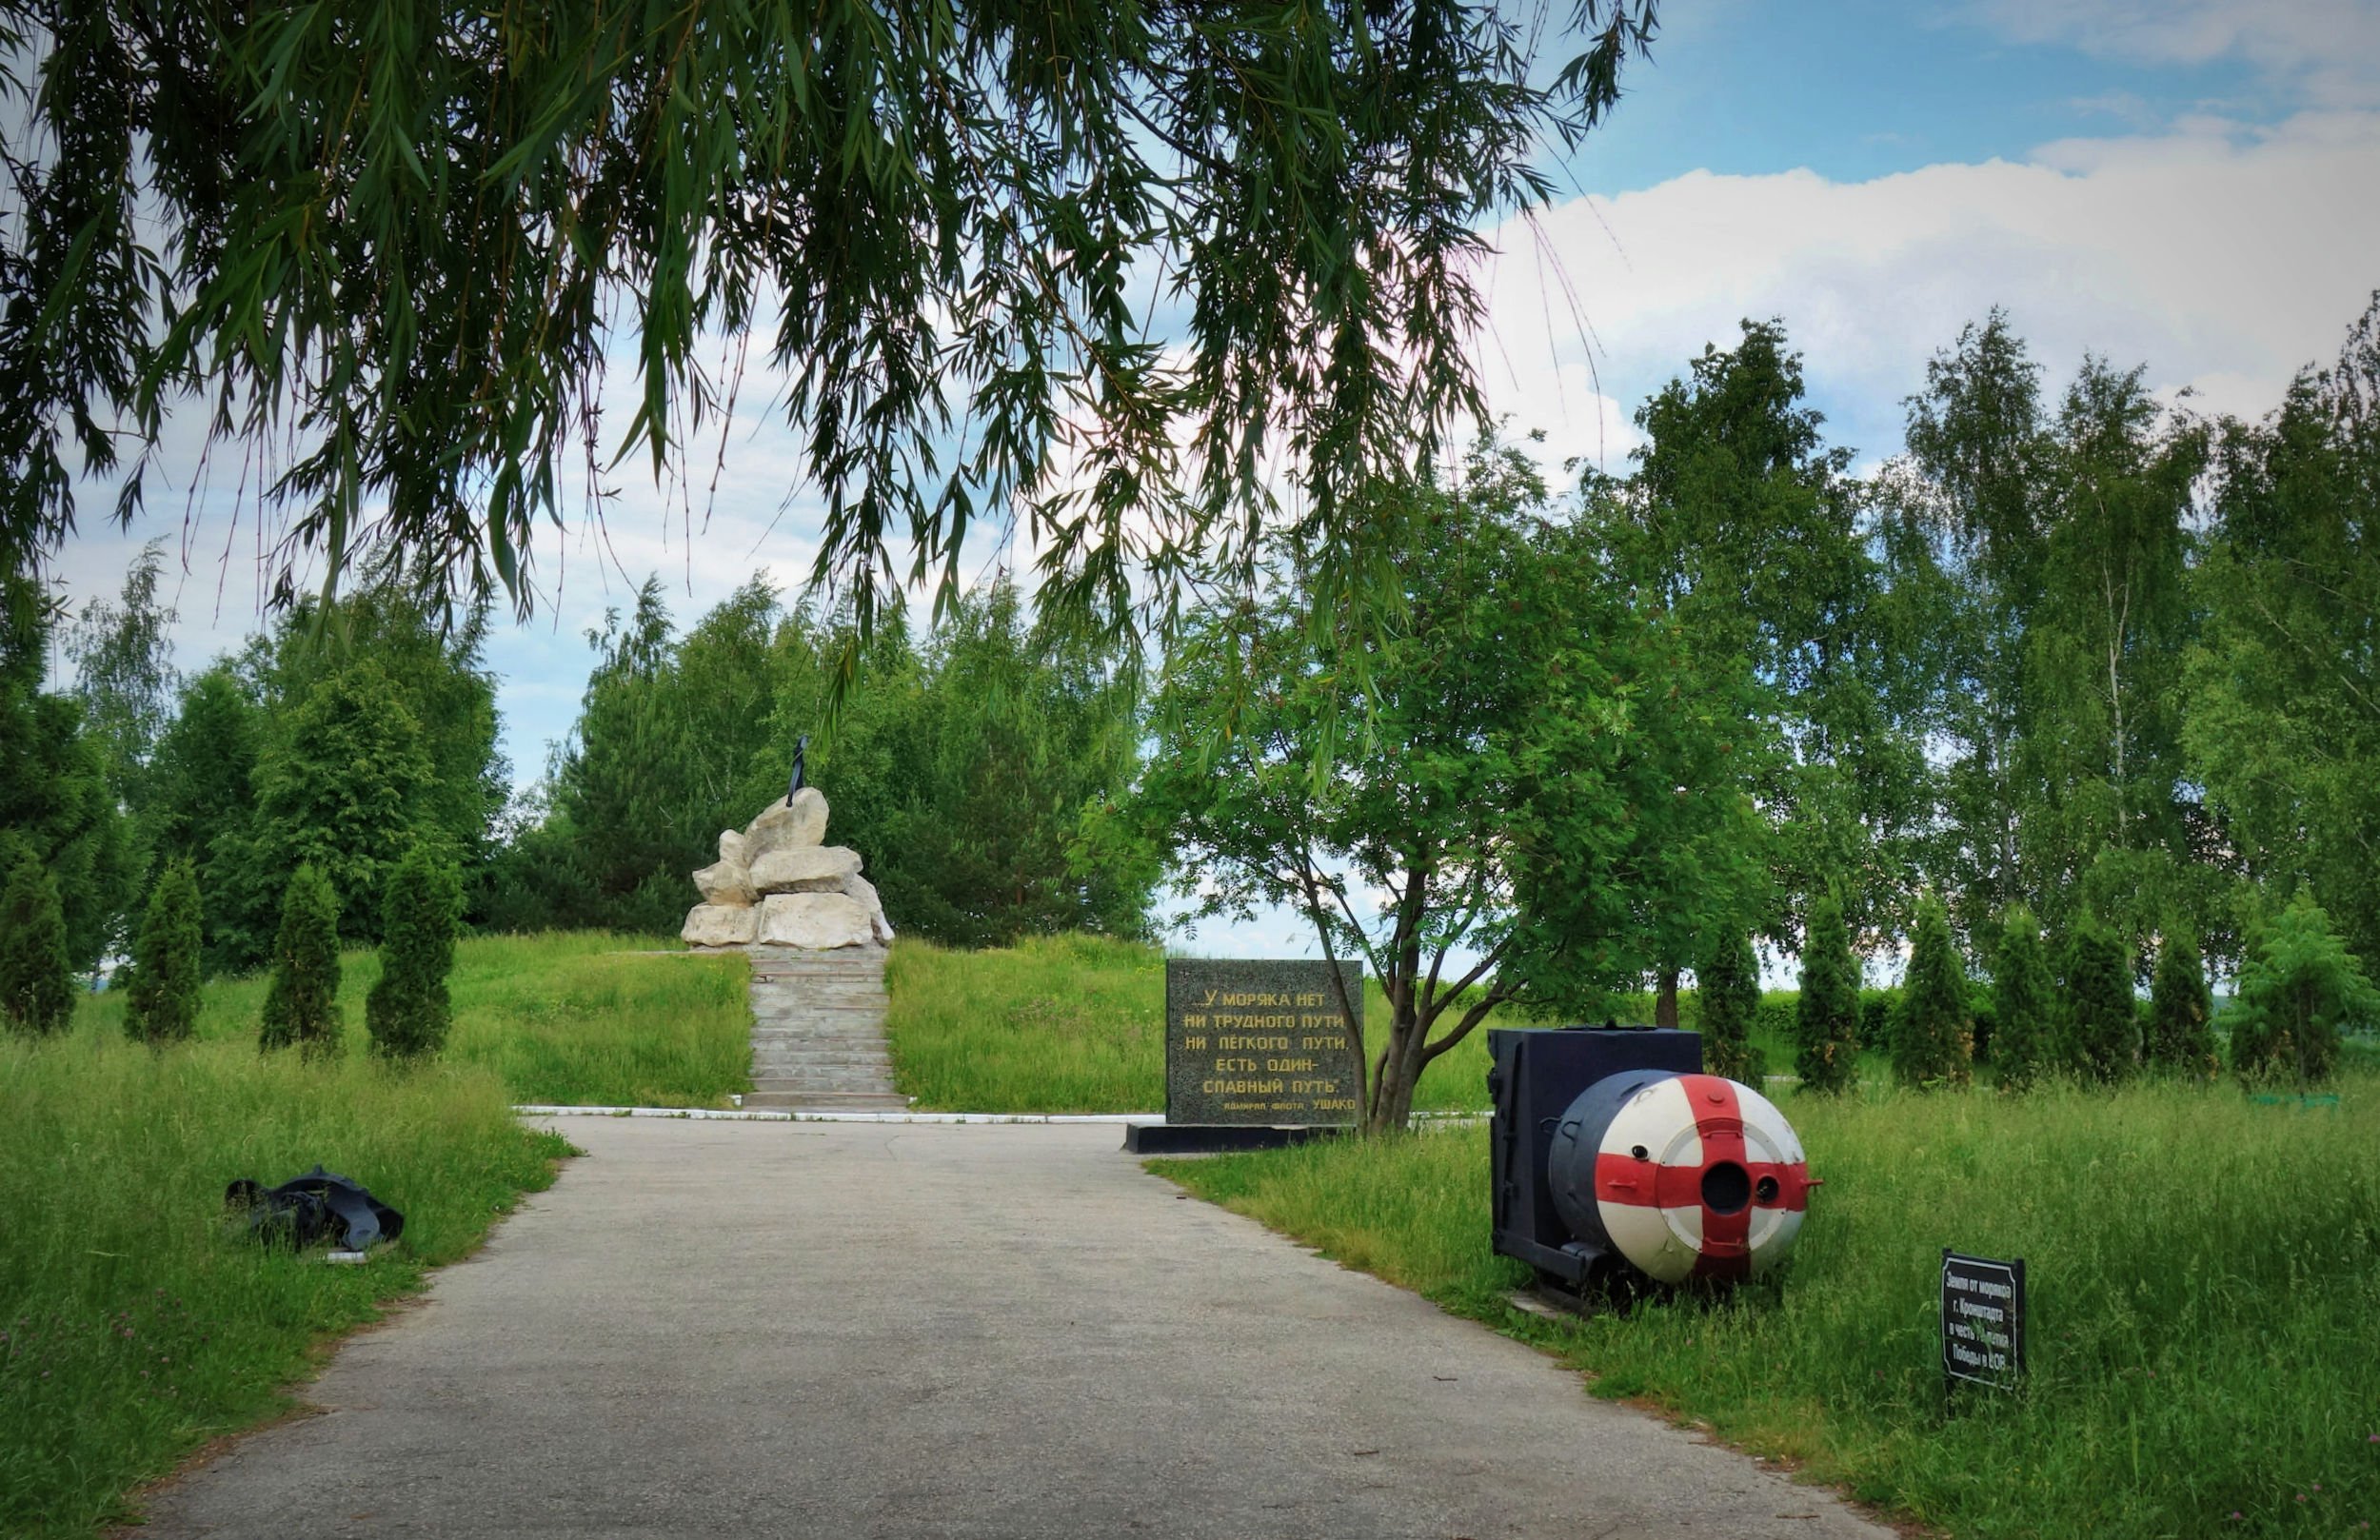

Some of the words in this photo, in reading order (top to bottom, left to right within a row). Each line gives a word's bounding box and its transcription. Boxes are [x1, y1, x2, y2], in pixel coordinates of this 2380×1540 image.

[1222, 993, 1291, 1006] МОРЯКА
[1297, 993, 1325, 1006] НЕТ
[1183, 1015, 1206, 1028] НИ
[1213, 1015, 1296, 1029] ТРУДНОГО
[1185, 1037, 1206, 1050] НИ
[1216, 1058, 1257, 1072] ЕСТЬ
[1202, 1078, 1283, 1094] СЛАВНЫЙ
[1223, 1102, 1266, 1111] АДМИРАЛ
[1271, 1102, 1304, 1111] ФЛОТА
[1312, 1099, 1357, 1111] УШАКО
[1947, 1271, 1969, 1291] Земля
[1969, 1278, 1978, 1293] от
[1959, 1297, 2004, 1324] Кронштадта
[1949, 1322, 1954, 1335] в
[1954, 1324, 1975, 1341] честь
[1953, 1343, 1981, 1368] Победы
[1982, 1354, 1988, 1368] в
